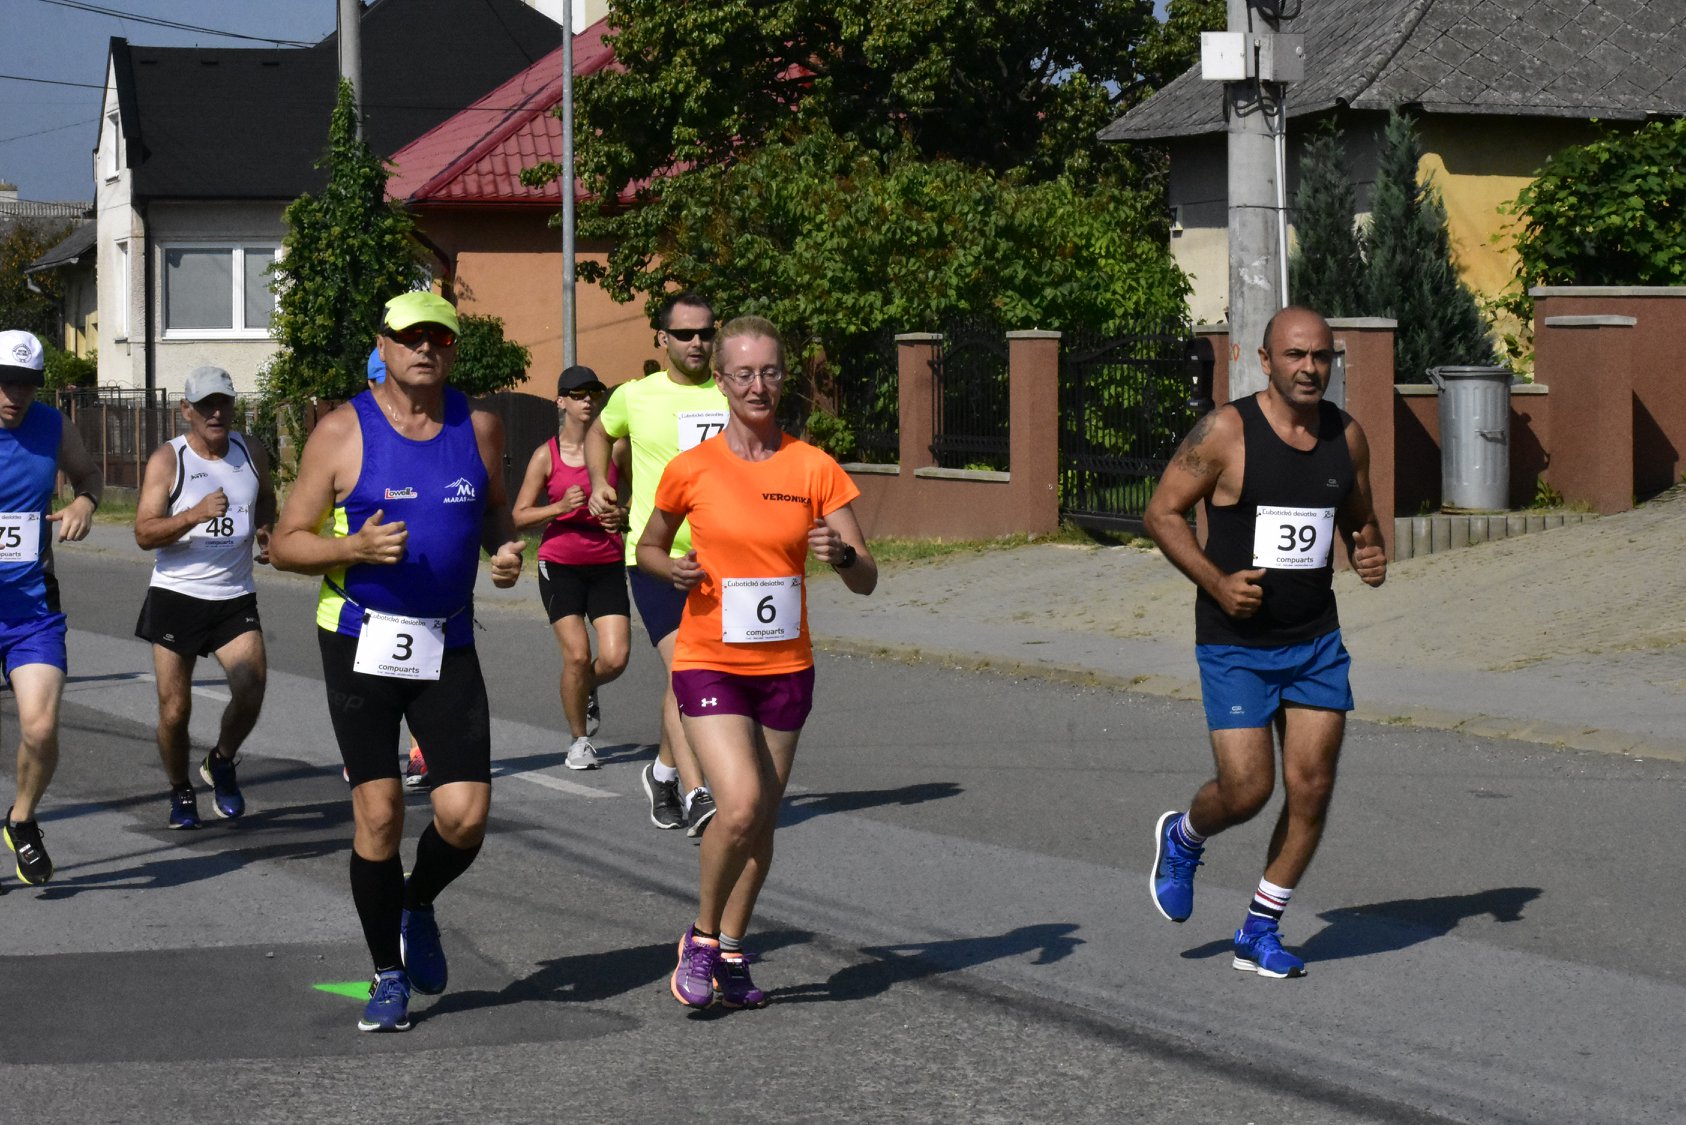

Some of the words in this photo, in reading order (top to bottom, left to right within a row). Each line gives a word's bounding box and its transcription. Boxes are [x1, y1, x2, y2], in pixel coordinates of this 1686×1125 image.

[696, 423, 725, 443] 77
[761, 493, 812, 505] VERONIKA
[205, 517, 234, 537] 48
[1277, 524, 1317, 553] 39
[1276, 556, 1314, 564] compuarts
[756, 594, 776, 624] 6
[745, 627, 785, 637] compuarts
[391, 633, 414, 661] 3
[378, 664, 420, 674] compuarts
